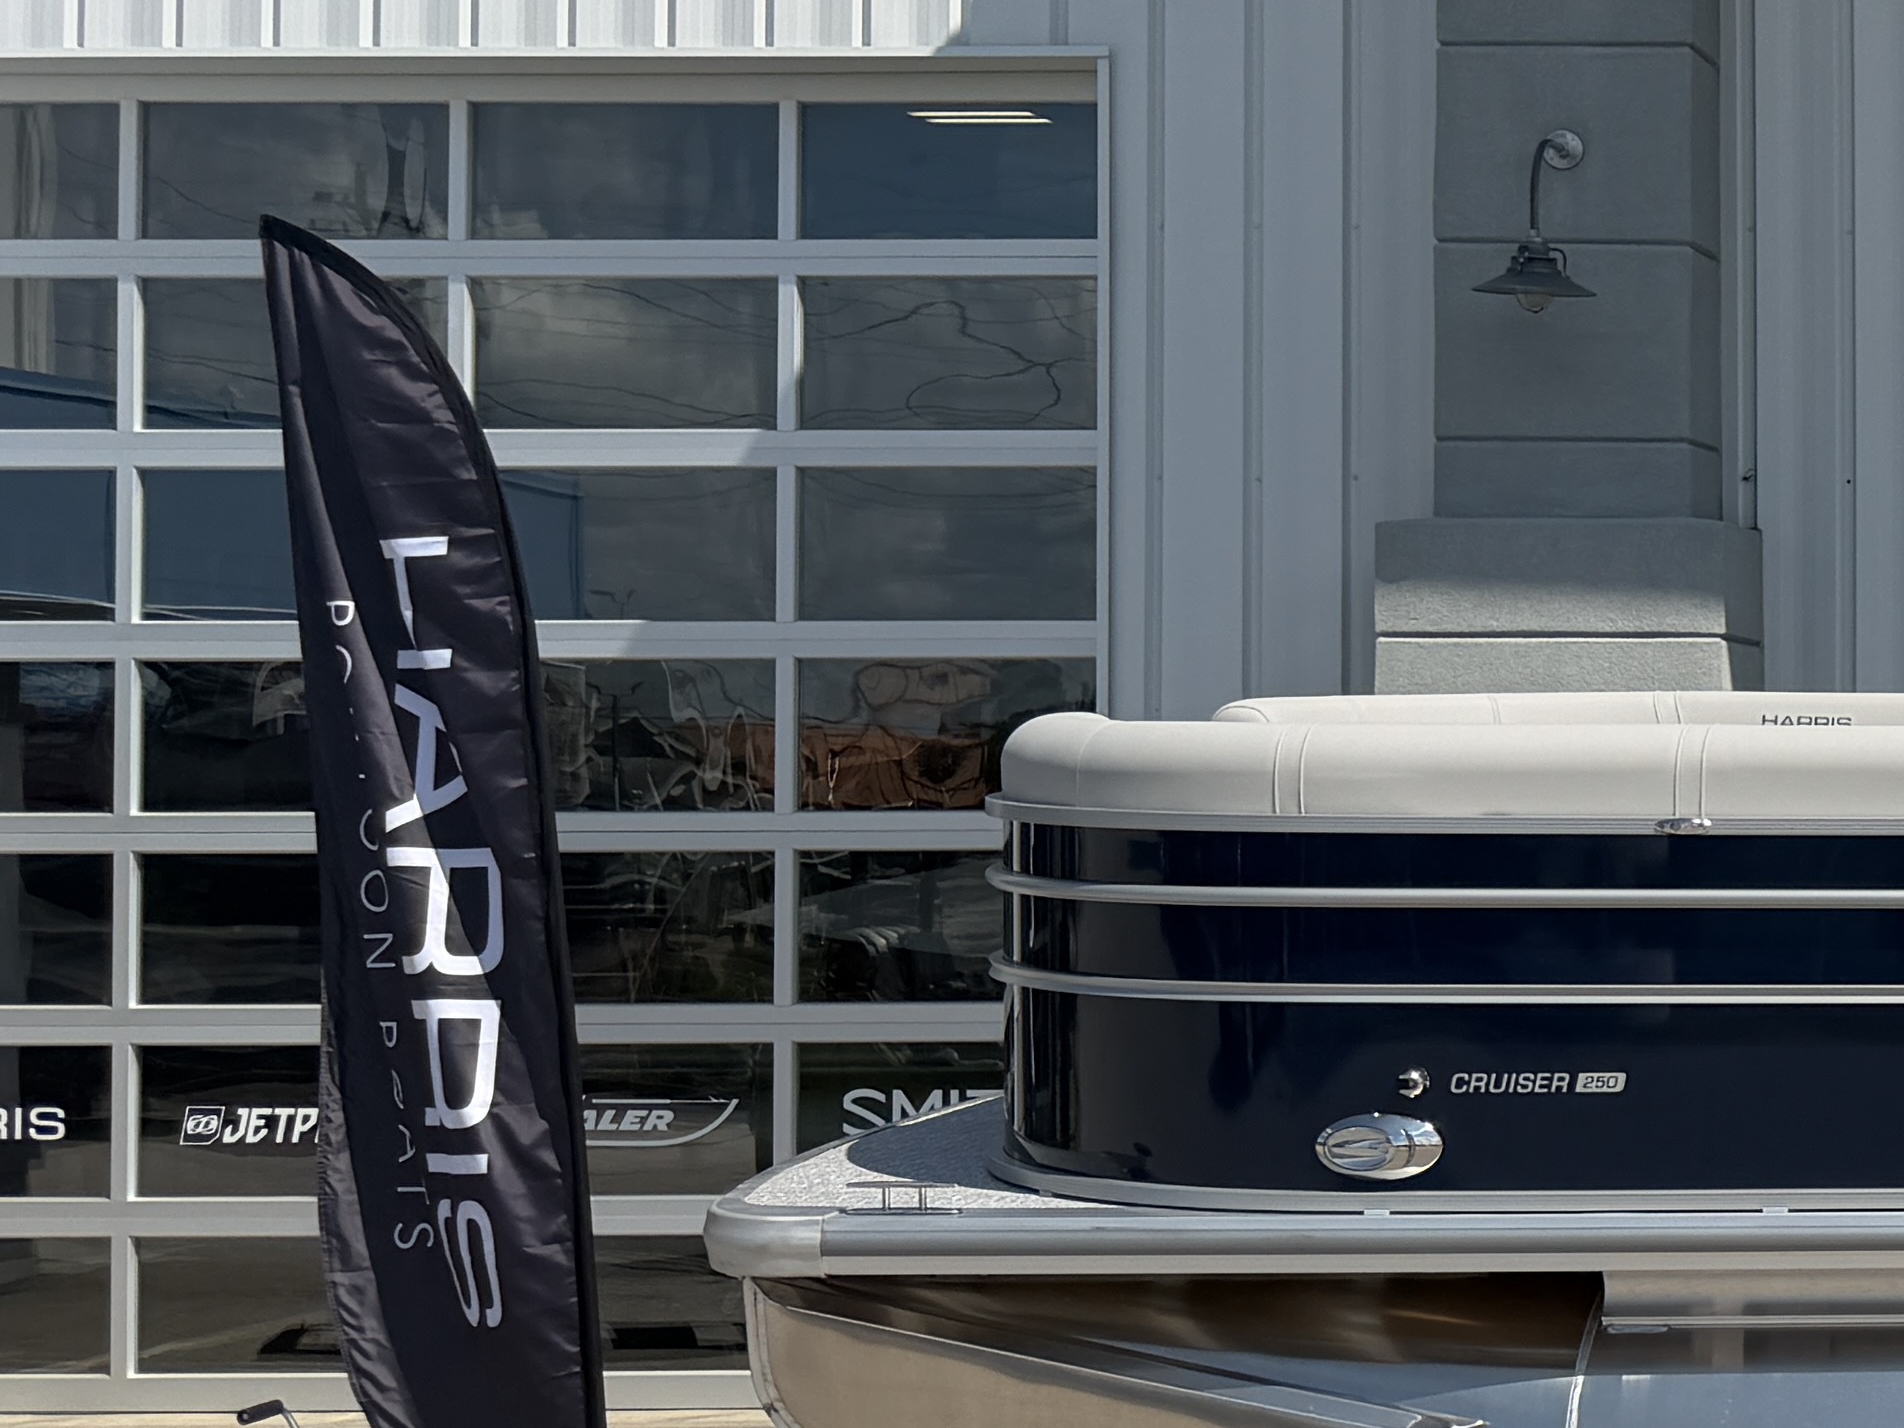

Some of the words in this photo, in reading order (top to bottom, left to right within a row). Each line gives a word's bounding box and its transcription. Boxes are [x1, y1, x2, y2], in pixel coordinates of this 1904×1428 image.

[1450, 1072, 1570, 1094] CRUISER
[1582, 1075, 1619, 1089] 250
[222, 1108, 319, 1143] JETP
